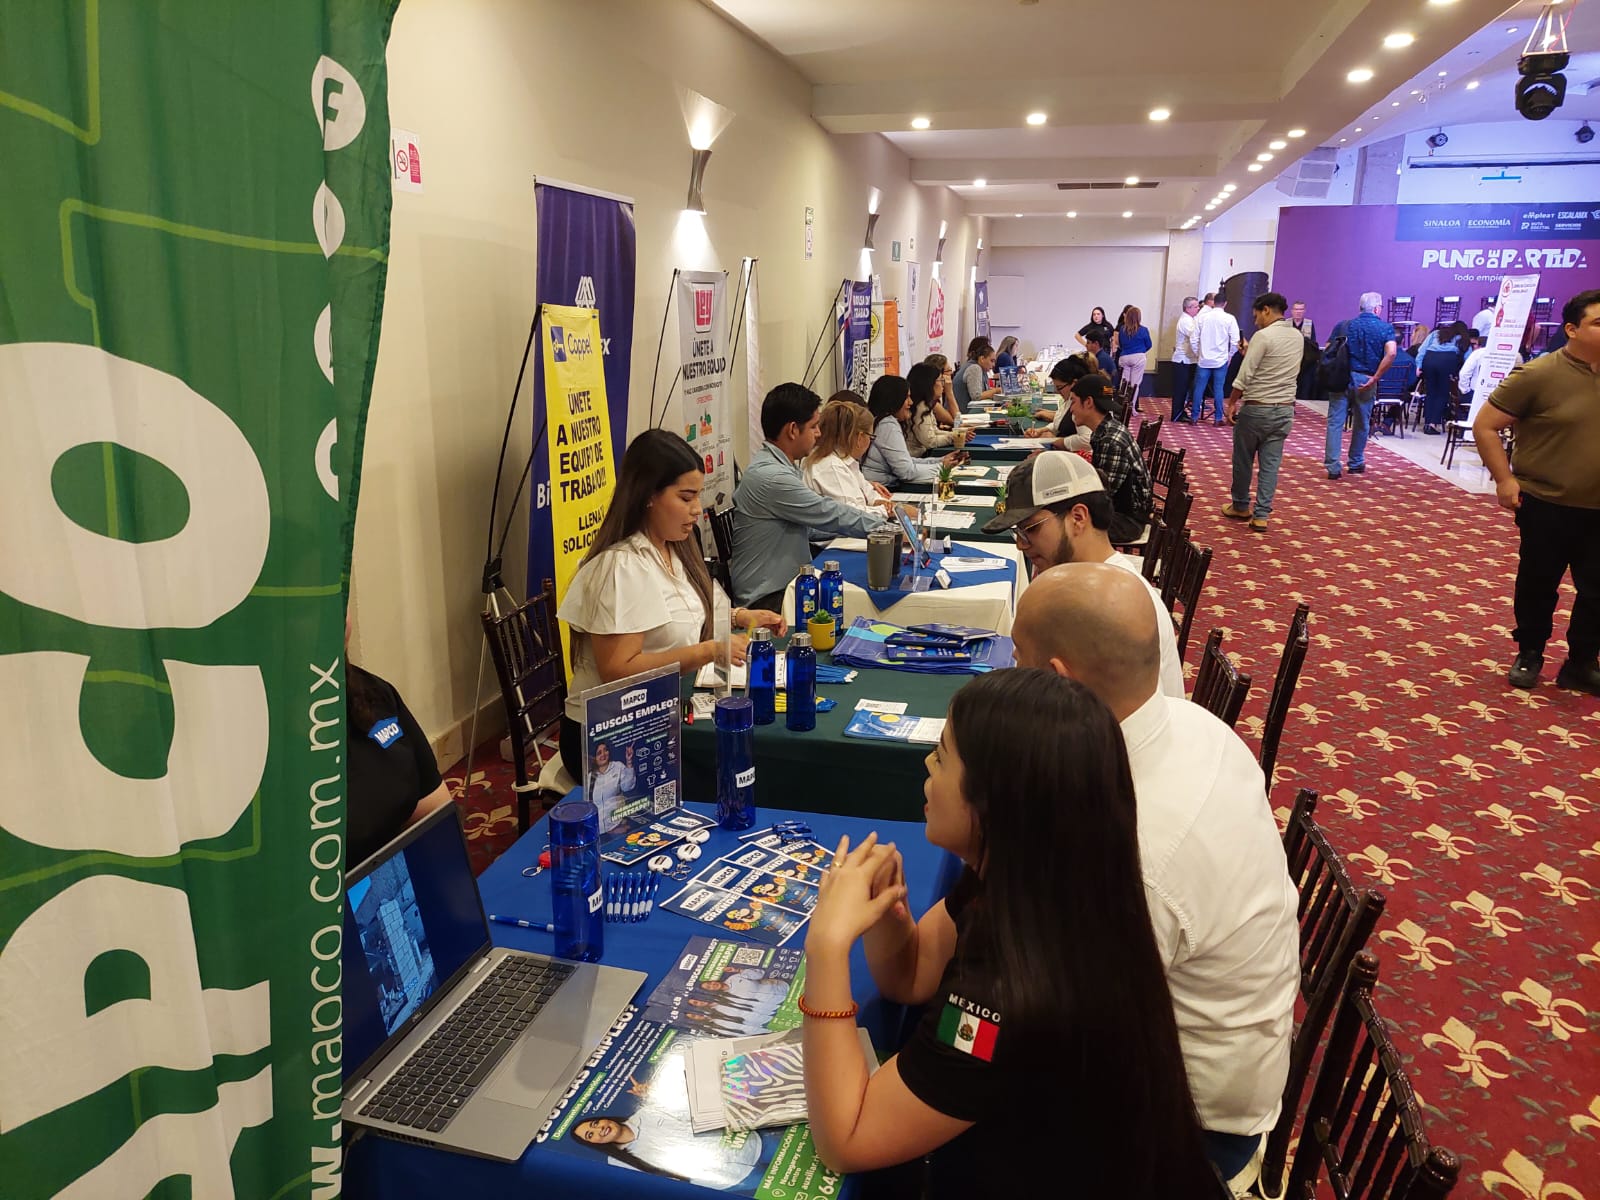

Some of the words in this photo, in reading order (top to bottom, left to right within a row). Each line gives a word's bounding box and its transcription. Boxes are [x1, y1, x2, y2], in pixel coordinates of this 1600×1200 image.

[1424, 219, 1460, 227] SINALOA
[1468, 218, 1511, 226] ECONOMÍA
[1500, 248, 1587, 268] PARTIDA
[1454, 273, 1474, 282] Todo
[567, 333, 593, 361] Coppel
[568, 388, 592, 415] ÚNETE
[556, 424, 568, 447] A
[570, 415, 601, 445] NUESTRO
[594, 441, 604, 461] DE
[623, 693, 646, 705] MAPCO
[589, 713, 634, 736] ¿BUSCAS
[635, 697, 679, 717] EMPLEO?
[374, 722, 400, 744] MAPCO
[713, 868, 735, 884] MAPCO
[686, 890, 710, 909] MAPCO
[948, 993, 1001, 1023] MEXICO
[554, 1101, 582, 1137] Documentos
[763, 1175, 775, 1189] MÁS
[770, 1134, 794, 1176] INFORMACIÓN
[788, 1167, 801, 1186] Centro
